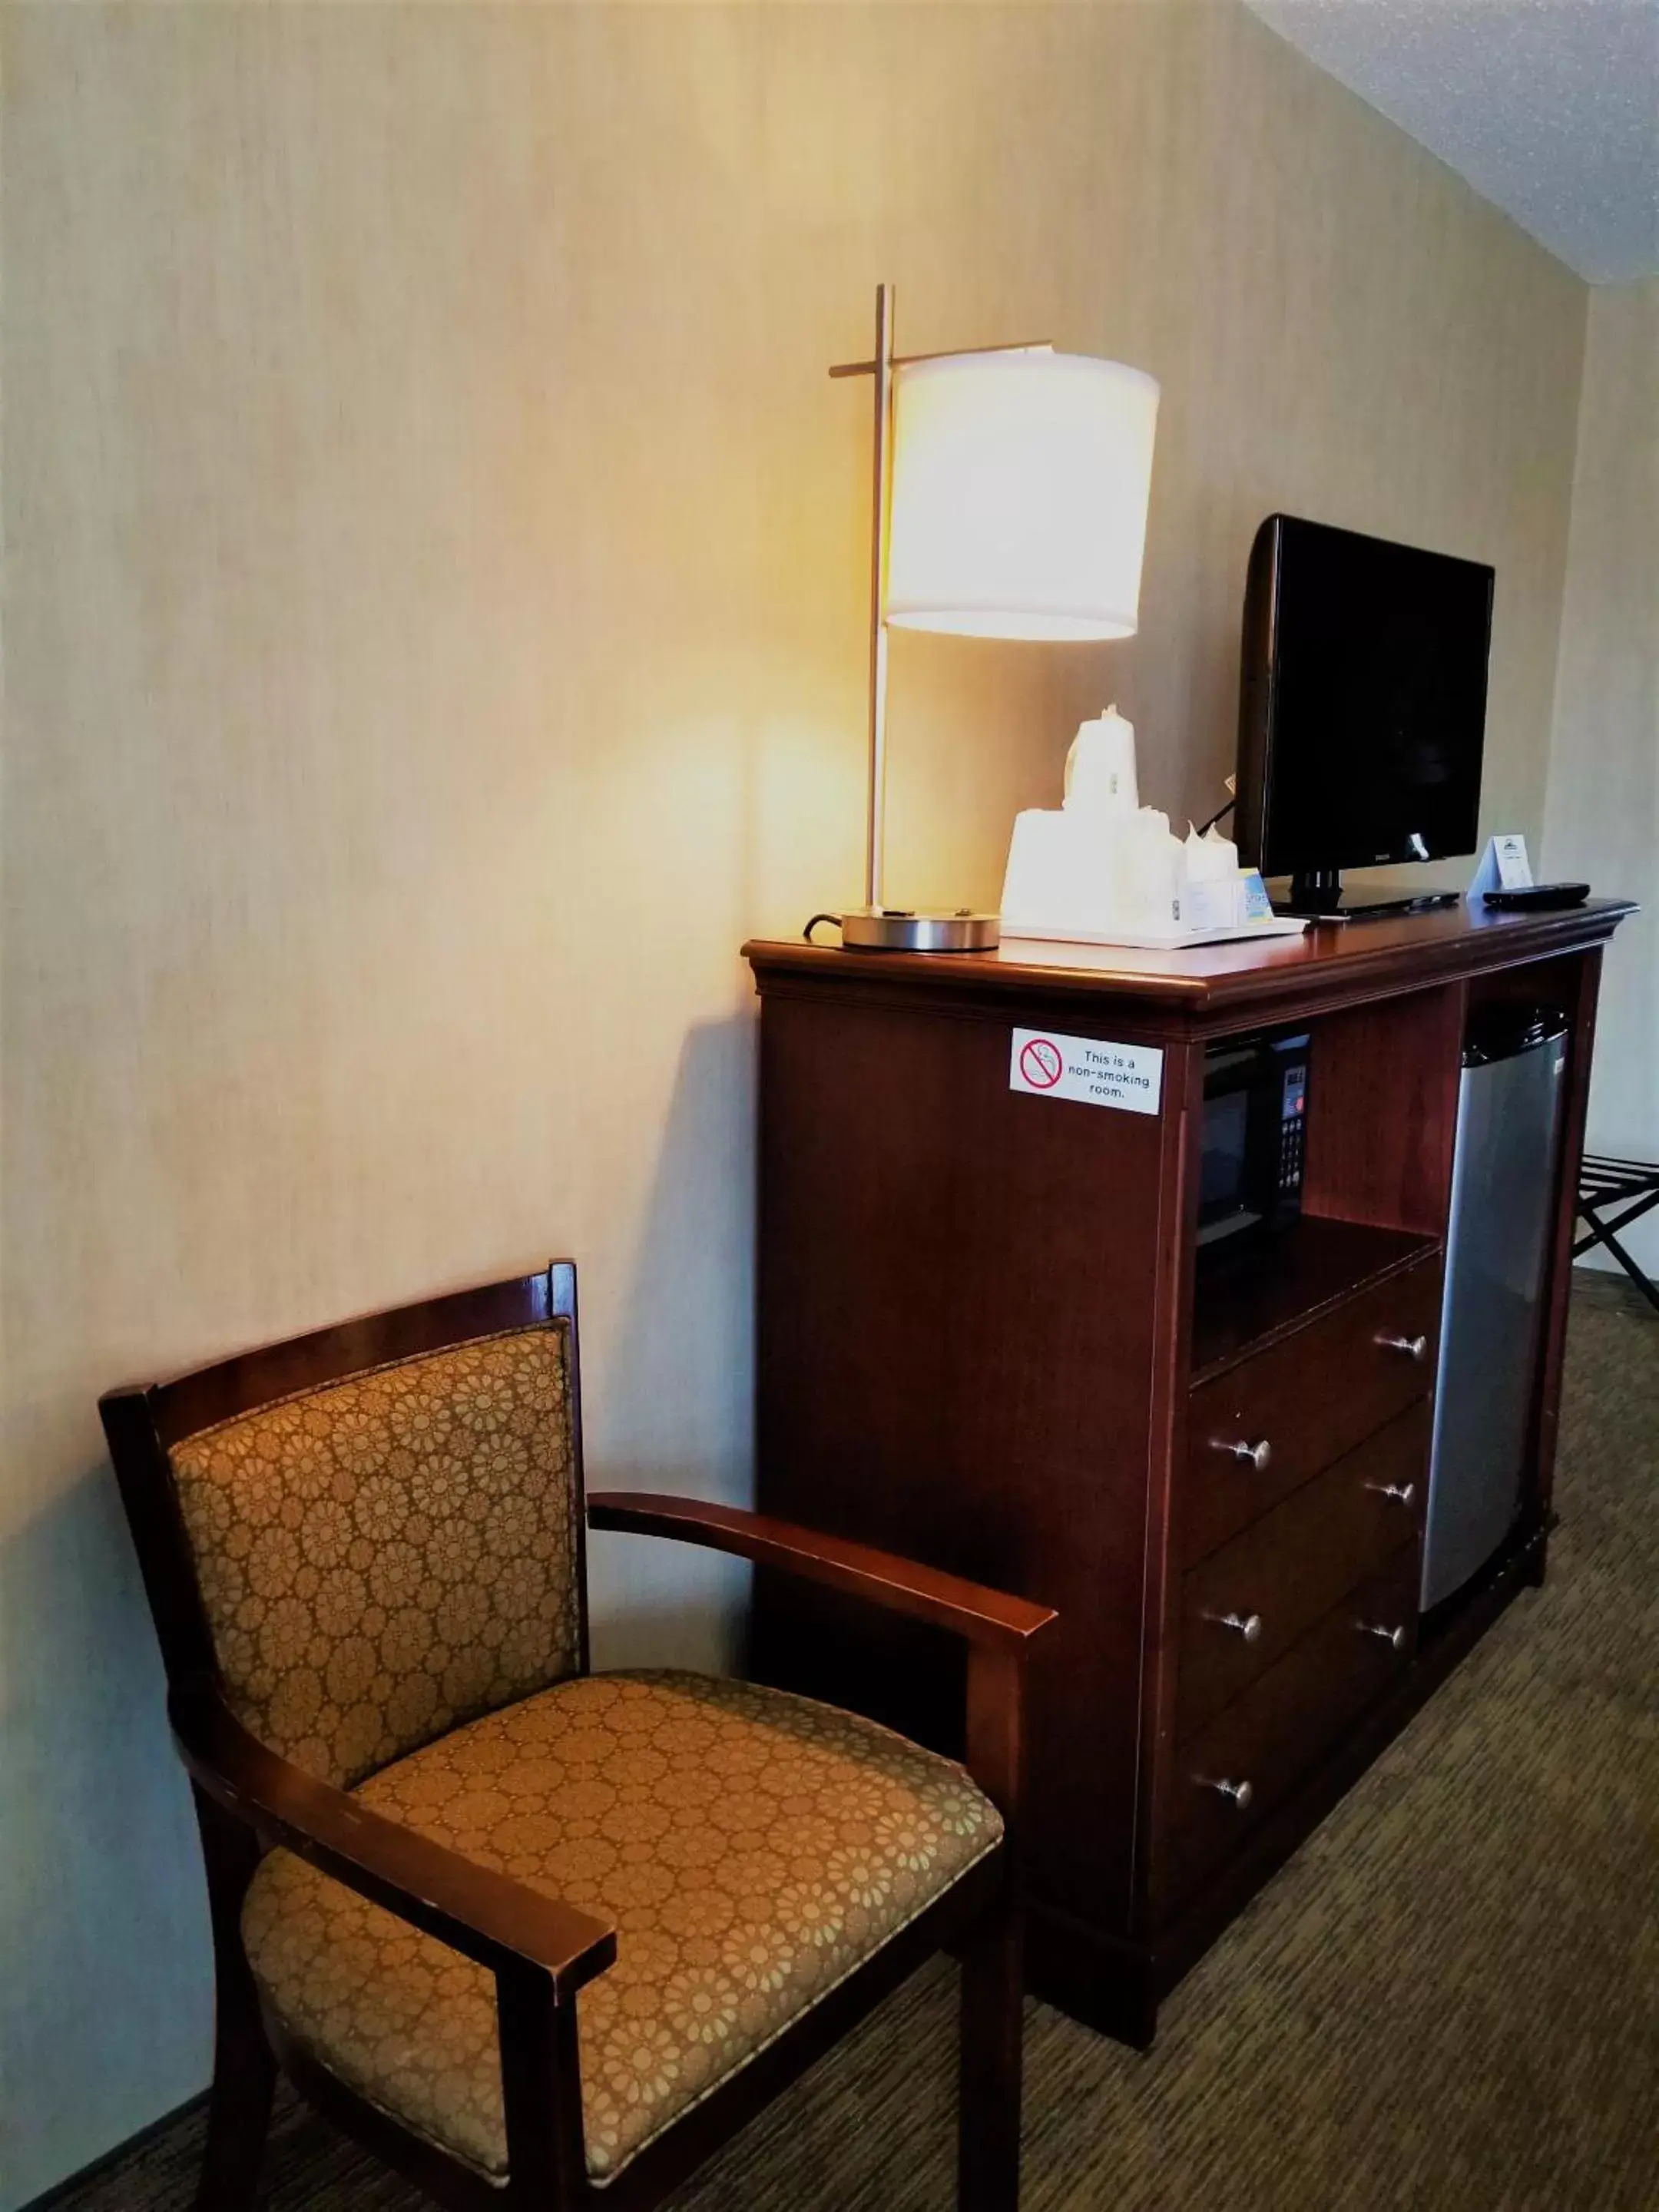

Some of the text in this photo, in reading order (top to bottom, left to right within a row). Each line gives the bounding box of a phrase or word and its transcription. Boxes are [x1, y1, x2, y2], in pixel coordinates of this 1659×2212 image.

[1085, 1051, 1135, 1069] This is a
[1068, 1066, 1150, 1088] non-smoking
[1089, 1084, 1125, 1098] room.
